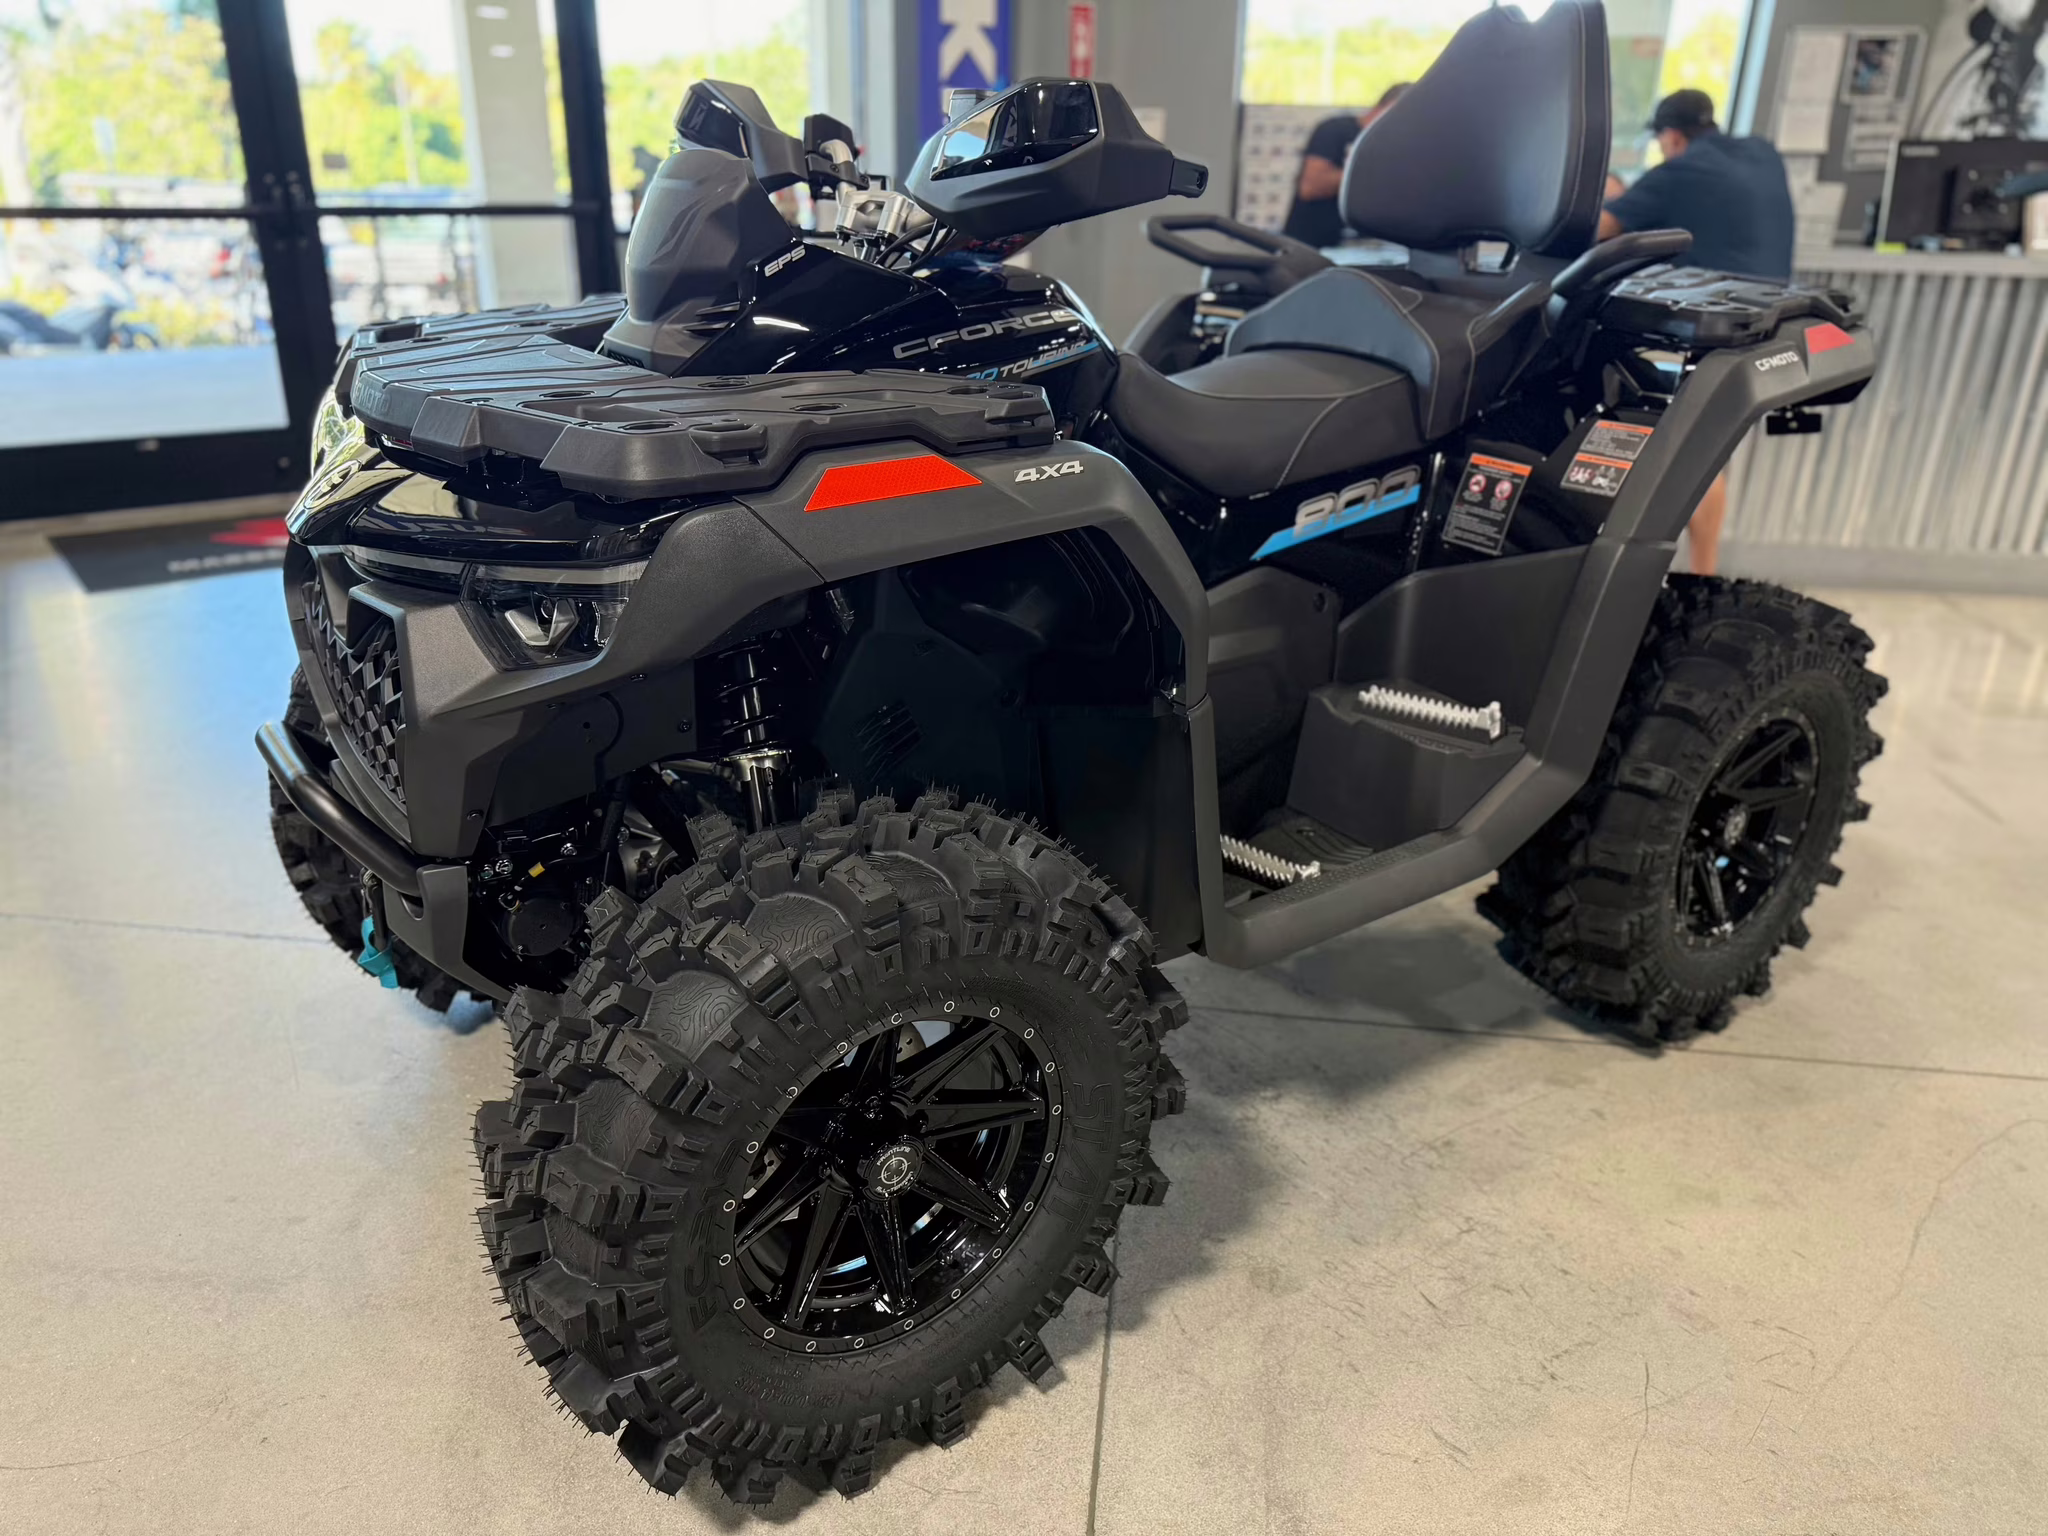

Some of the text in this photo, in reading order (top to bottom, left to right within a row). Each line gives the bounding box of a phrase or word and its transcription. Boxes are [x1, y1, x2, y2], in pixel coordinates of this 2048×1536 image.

[764, 245, 807, 278] EPS
[893, 309, 1081, 361] CFORCE
[1000, 340, 1088, 378] TOURING
[1754, 350, 1799, 371] CFMOTO
[1294, 464, 1421, 540] 800
[876, 1146, 911, 1166] FRONTLINE
